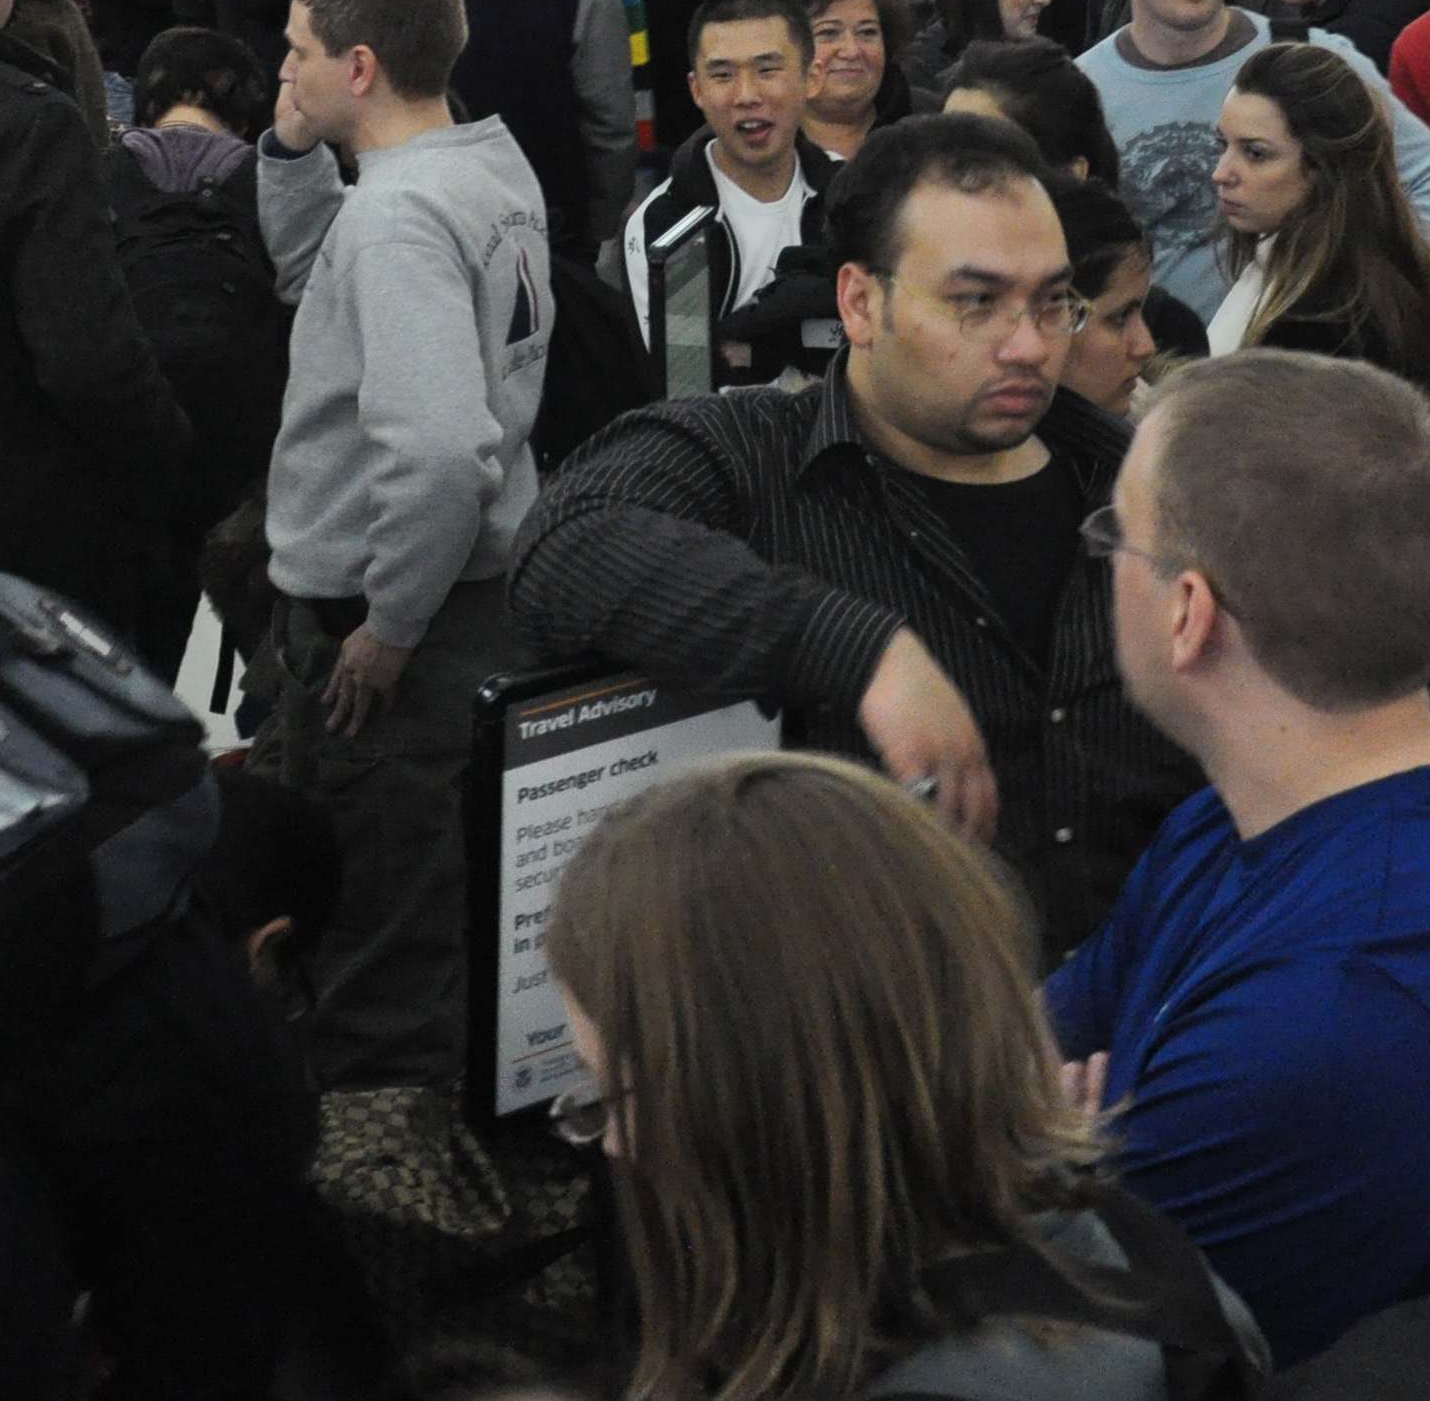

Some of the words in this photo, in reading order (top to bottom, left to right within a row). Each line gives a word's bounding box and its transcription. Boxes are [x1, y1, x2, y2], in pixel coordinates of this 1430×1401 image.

[518, 709, 575, 740] Travel
[578, 688, 658, 722] Advisory
[517, 765, 606, 804] Passenger
[609, 749, 659, 777] check
[516, 814, 573, 843] Please
[515, 842, 548, 868] and
[512, 968, 548, 994] Just
[526, 1023, 567, 1046] Your
